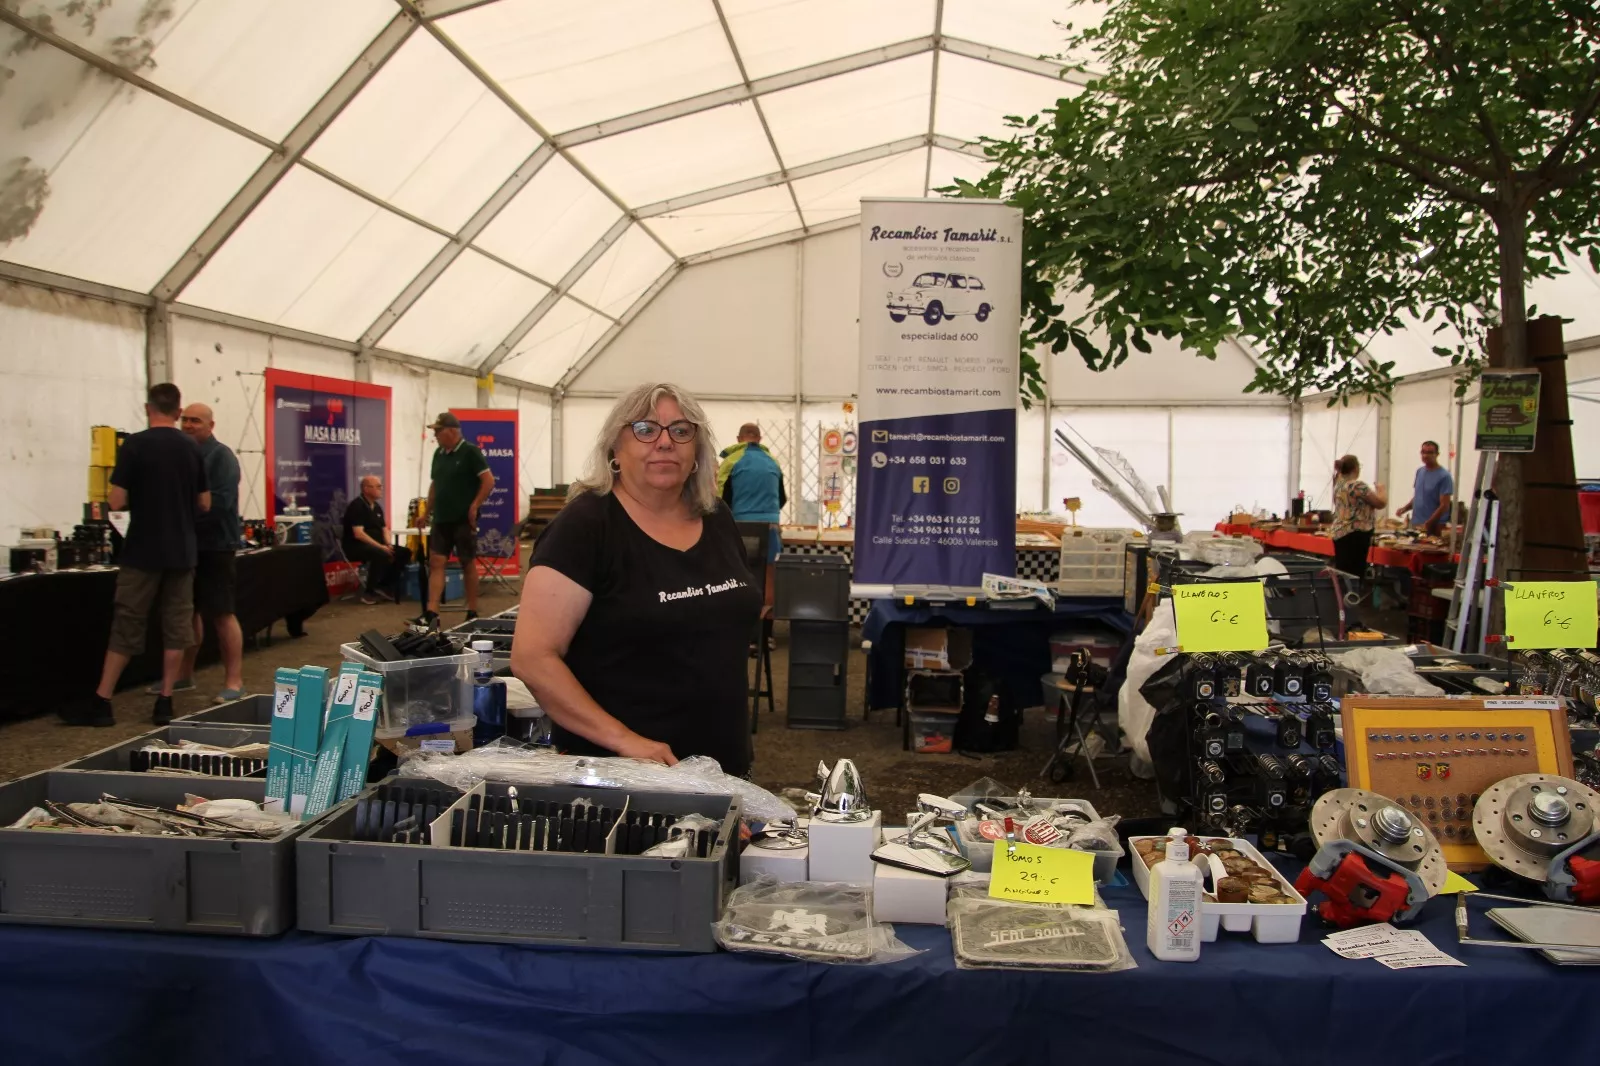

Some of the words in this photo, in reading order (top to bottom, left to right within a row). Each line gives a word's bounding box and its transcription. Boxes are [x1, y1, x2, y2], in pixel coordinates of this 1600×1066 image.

[870, 225, 938, 241] Recambios
[943, 227, 997, 242] Tamarit
[901, 332, 957, 342] especialidad
[960, 333, 979, 341] 600
[876, 387, 1001, 396] www.recambiostamarit.com
[305, 425, 329, 441] MASA
[331, 427, 337, 442] &
[338, 428, 360, 443] MASA
[889, 433, 1005, 442] tamarit@recambiostamarit.com
[889, 456, 905, 464] +34
[909, 456, 926, 464] 658
[930, 456, 946, 464] 031
[950, 457, 967, 465] 633
[908, 515, 924, 523] +34
[926, 515, 942, 523] 963
[957, 516, 968, 524] 62
[969, 516, 980, 524] 25
[895, 537, 918, 545] Sueca
[965, 538, 998, 546] Valencia
[659, 587, 704, 603] Recambios
[705, 579, 738, 595] Tamarit
[1181, 591, 1229, 600] LLAVEROS
[1516, 589, 1565, 600] LLAVEROS
